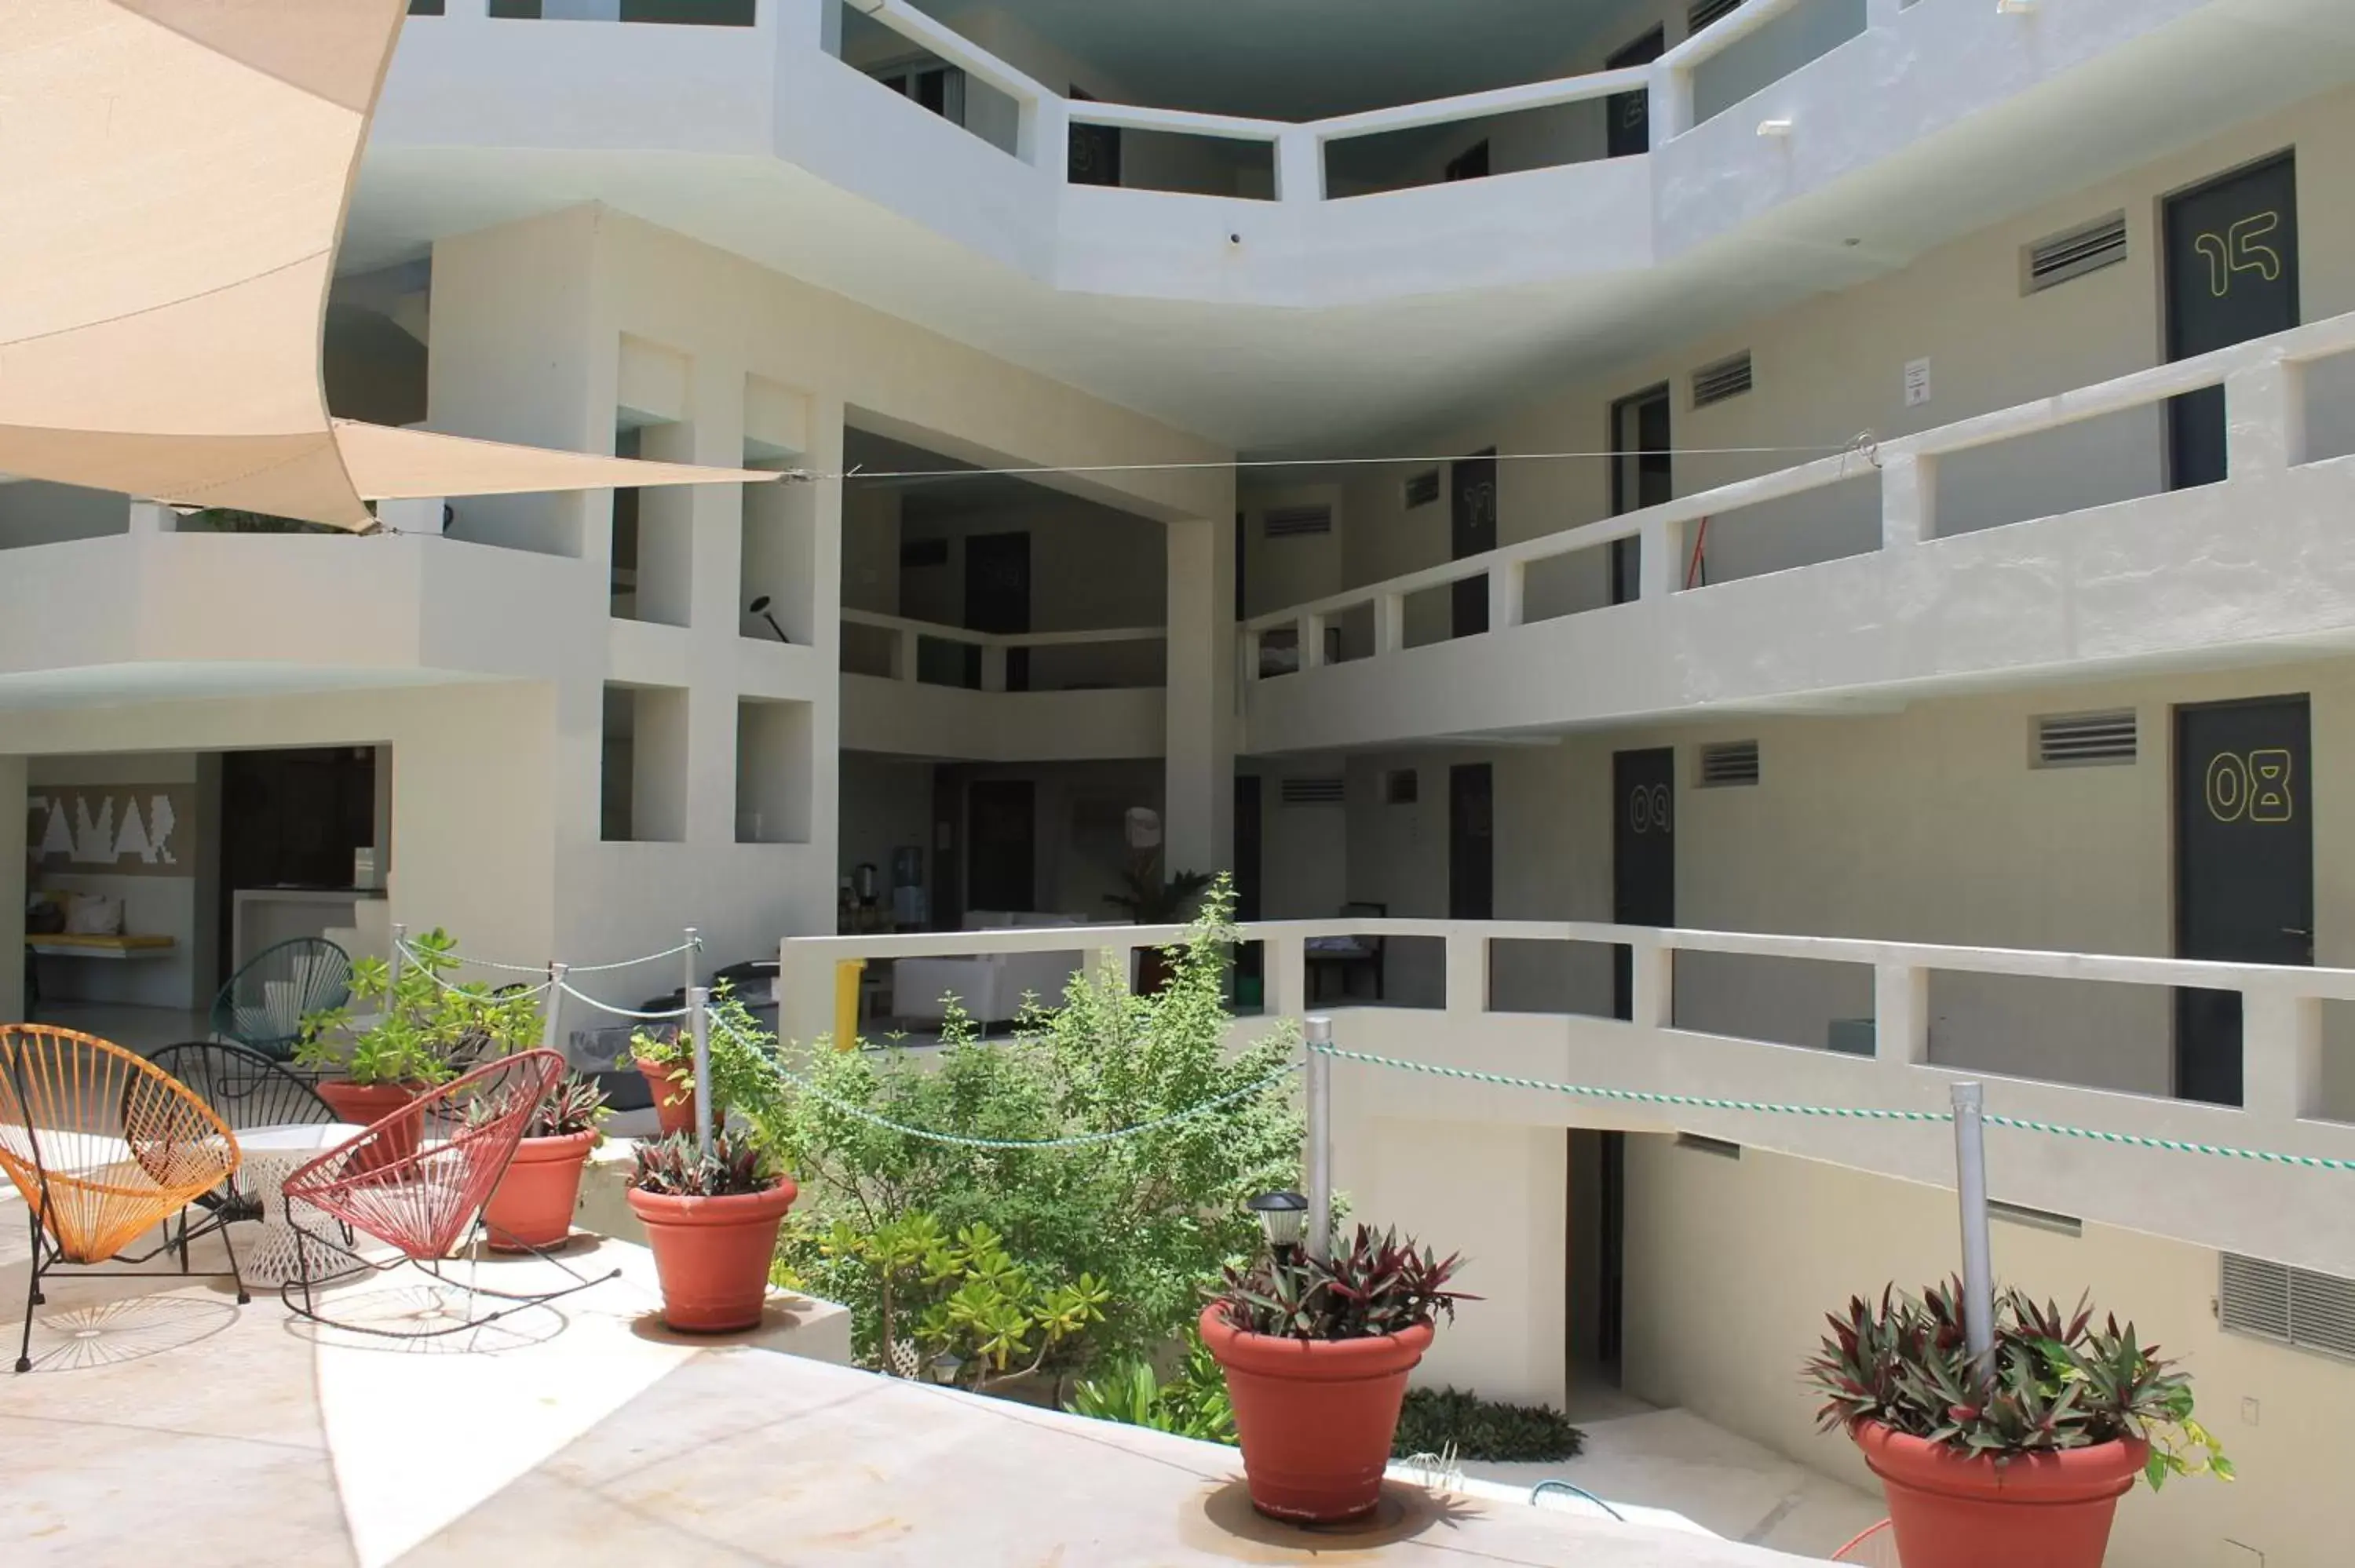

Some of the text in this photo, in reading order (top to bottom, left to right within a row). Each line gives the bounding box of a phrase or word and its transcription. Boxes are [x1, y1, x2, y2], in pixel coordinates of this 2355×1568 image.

[2194, 210, 2280, 297] 15
[1630, 782, 1671, 833] 09
[2207, 749, 2291, 822] 08
